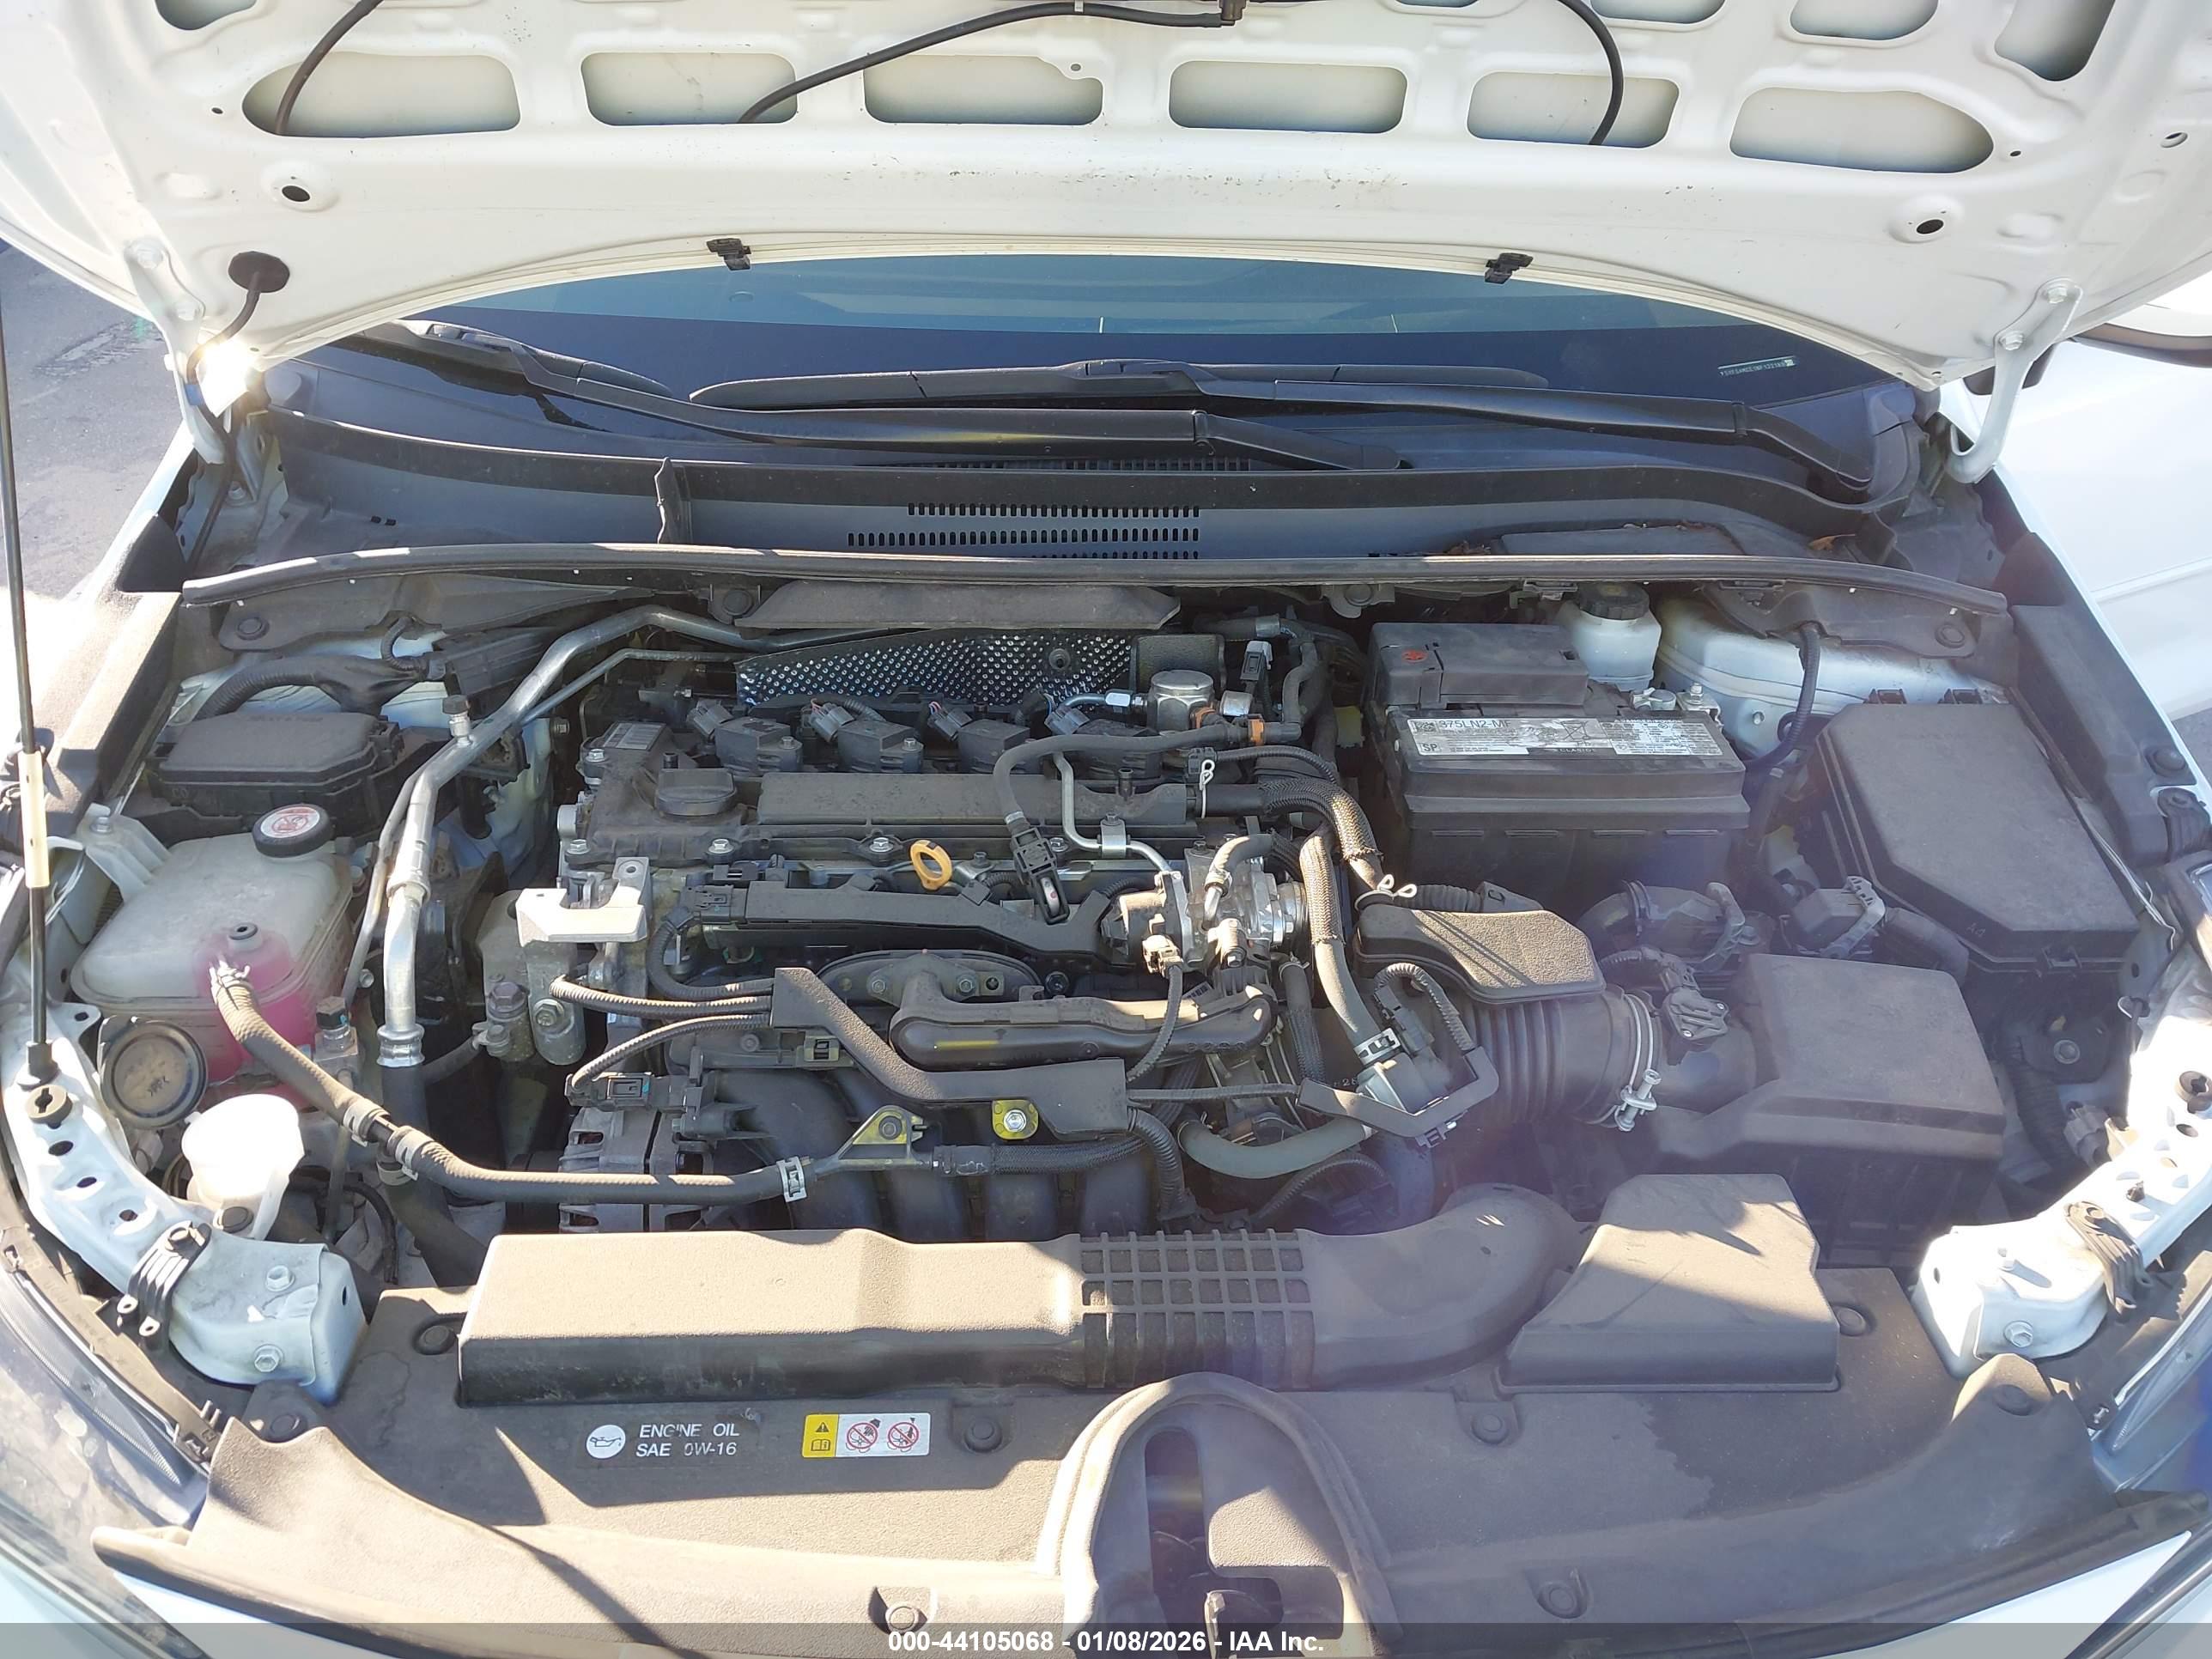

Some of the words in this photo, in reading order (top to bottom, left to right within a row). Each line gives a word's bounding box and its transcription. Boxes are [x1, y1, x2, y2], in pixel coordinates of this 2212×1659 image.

[1439, 719, 1512, 729] 375LN2-MF
[1422, 743, 1438, 753] SP
[640, 1424, 702, 1438] ENGINE
[713, 1423, 740, 1437] OIL
[635, 1443, 672, 1457] SAE
[684, 1442, 737, 1455] 0W-16
